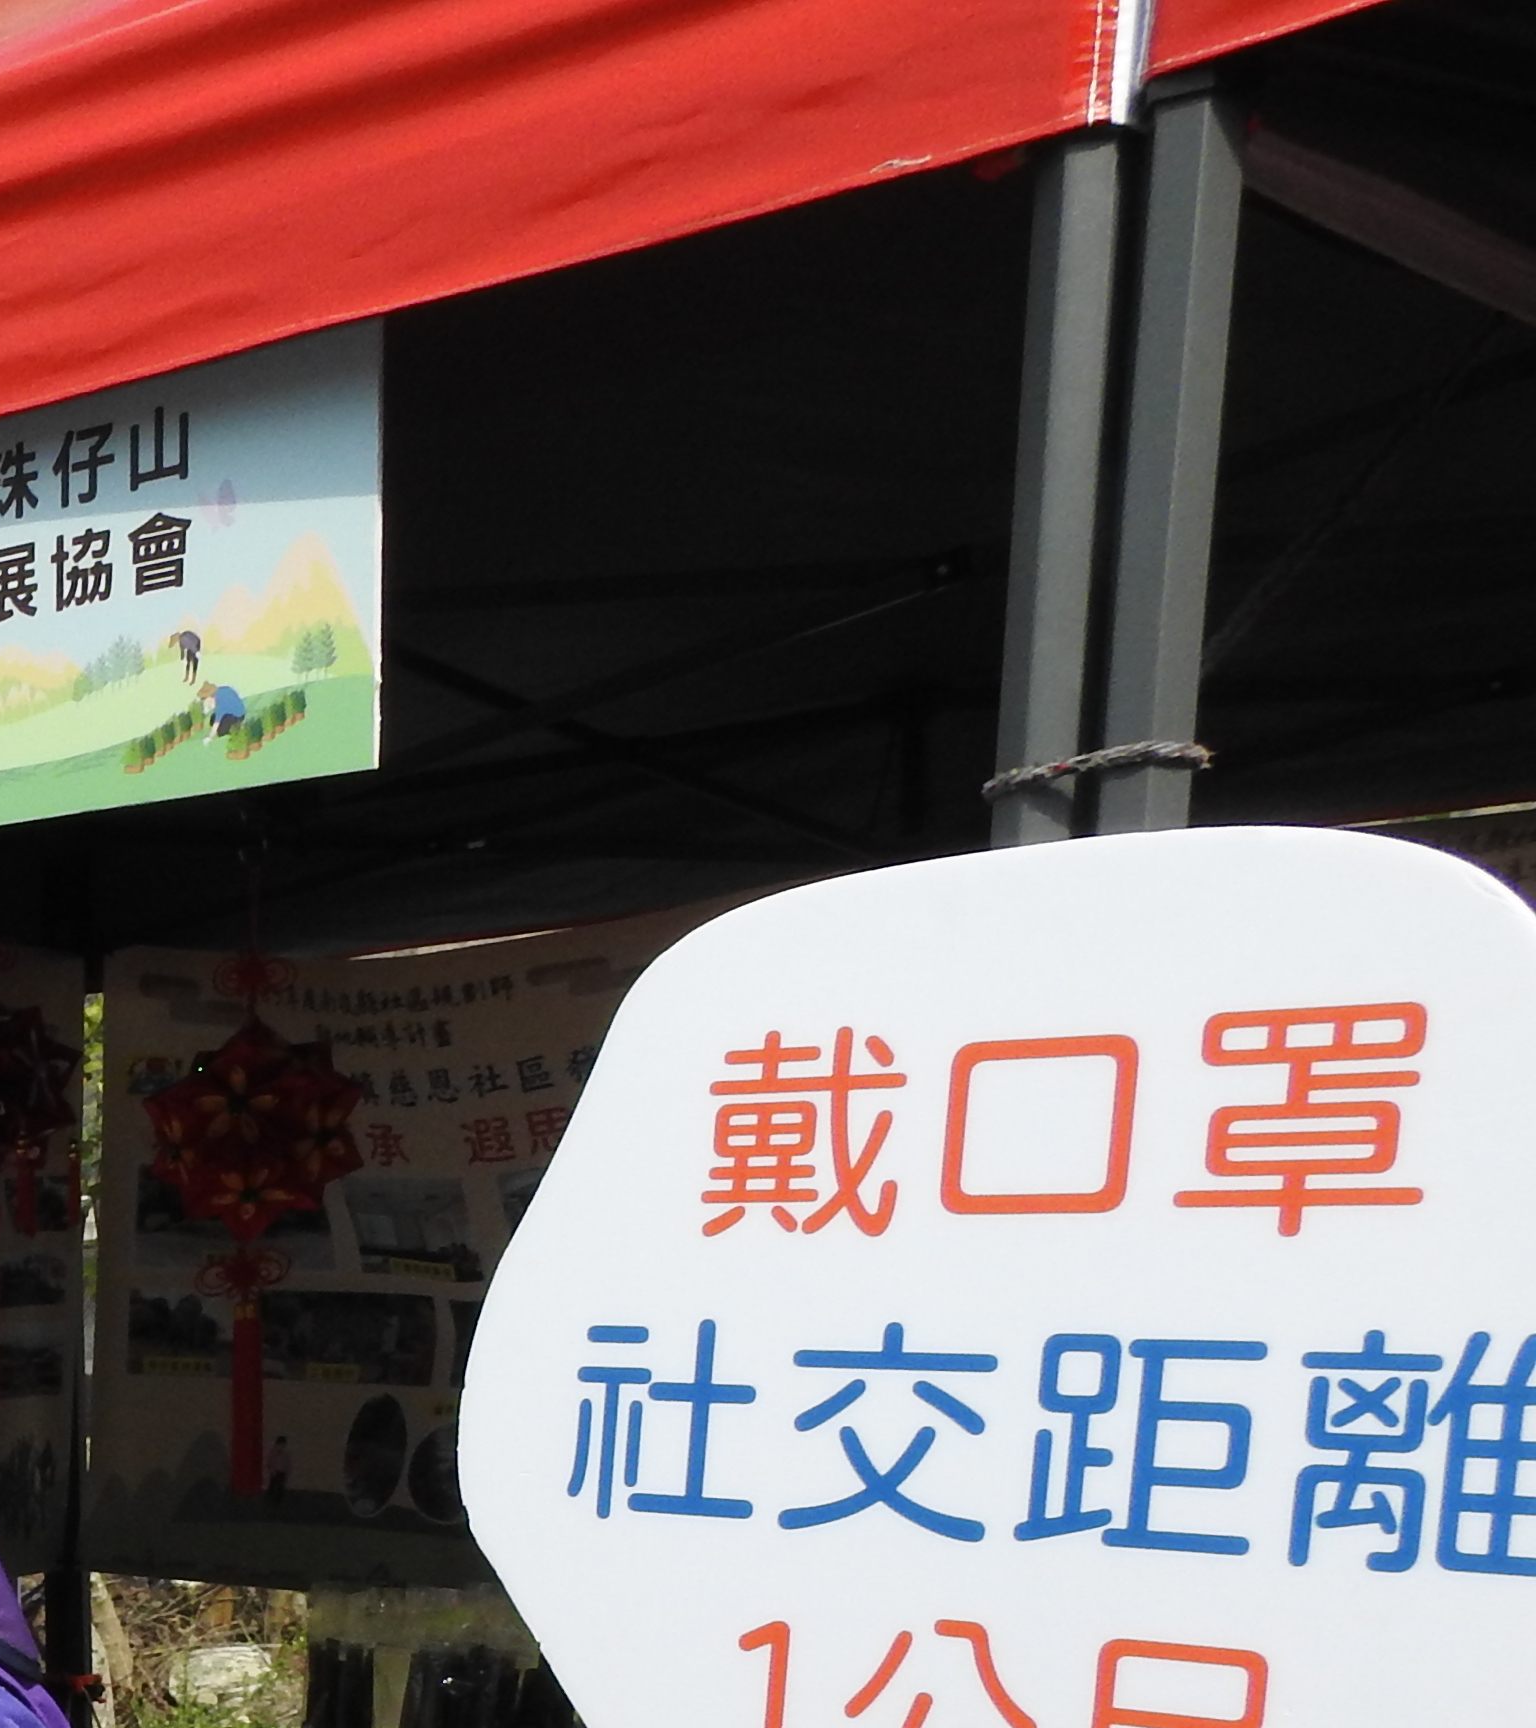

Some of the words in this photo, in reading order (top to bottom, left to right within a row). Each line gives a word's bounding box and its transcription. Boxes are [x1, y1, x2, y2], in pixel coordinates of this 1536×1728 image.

[700, 1000, 1429, 1238] 戴口罩
[566, 1317, 1536, 1578] 社交距離
